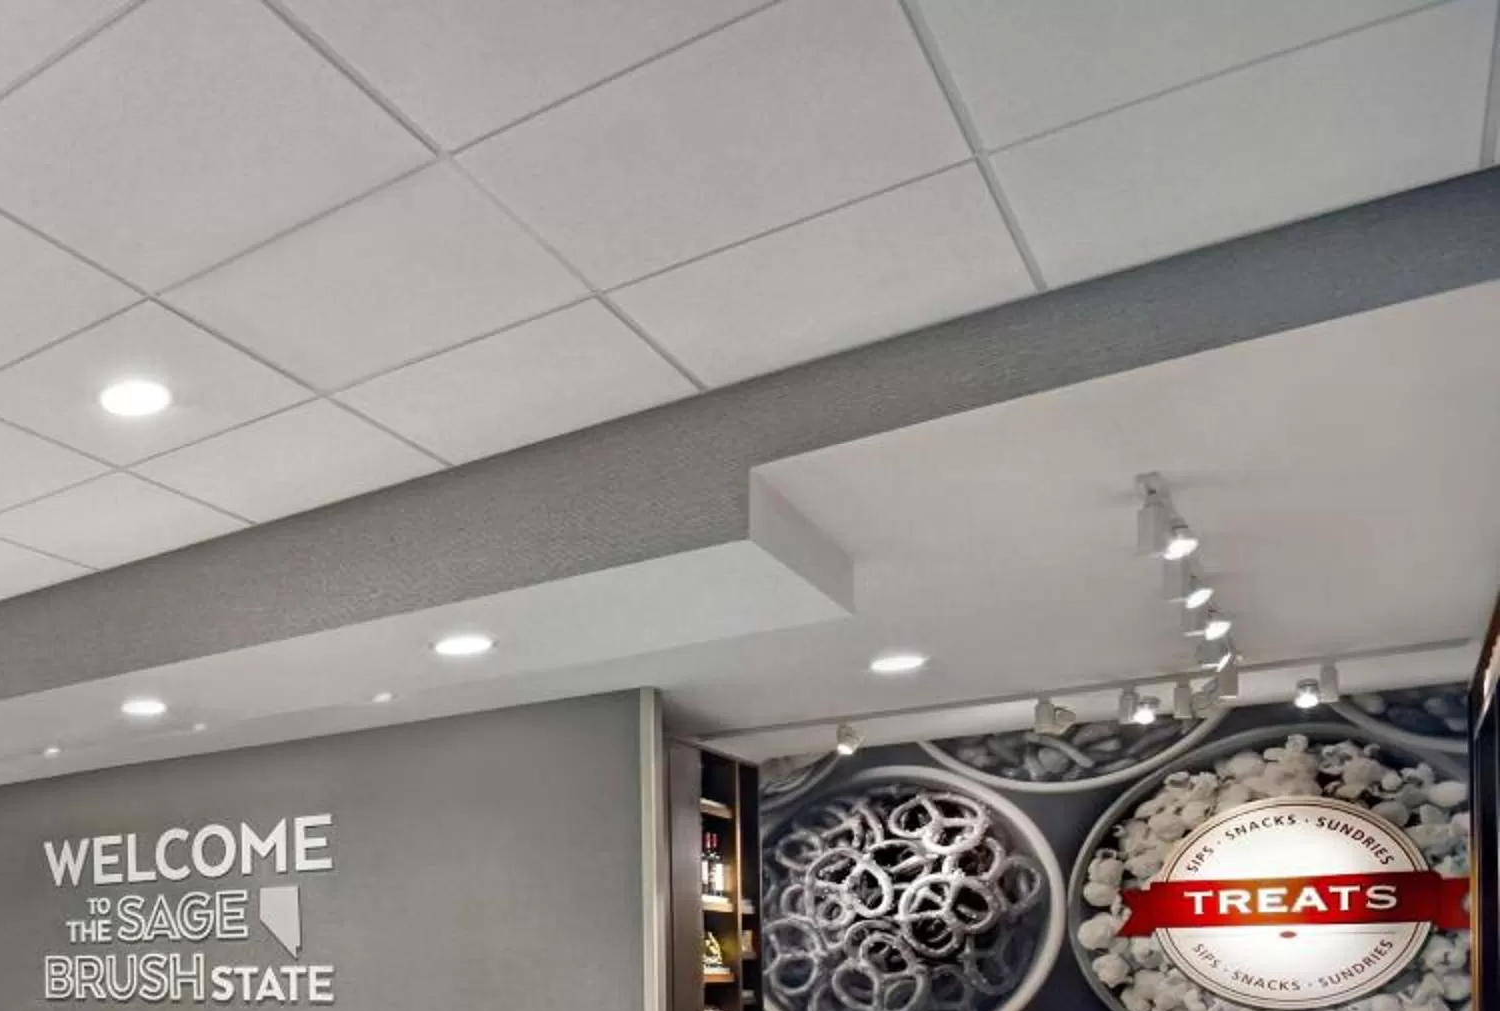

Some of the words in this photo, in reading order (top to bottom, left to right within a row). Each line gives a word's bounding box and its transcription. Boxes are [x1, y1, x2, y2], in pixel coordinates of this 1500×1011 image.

[44, 814, 333, 887] WELCOME
[1187, 845, 1215, 873] SIPS
[1225, 814, 1296, 841] SNACKS
[1315, 816, 1396, 866] SUNDRIES
[66, 920, 112, 943] THE
[117, 889, 249, 943] SAGE
[86, 898, 111, 915] TO
[1184, 885, 1398, 915] TREATS
[44, 953, 205, 1002] BRUSH
[211, 965, 334, 1003] STATE
[1192, 943, 1221, 969] SIPS
[1231, 970, 1301, 991] SNACKS
[1317, 939, 1394, 988] SUNDRIES
